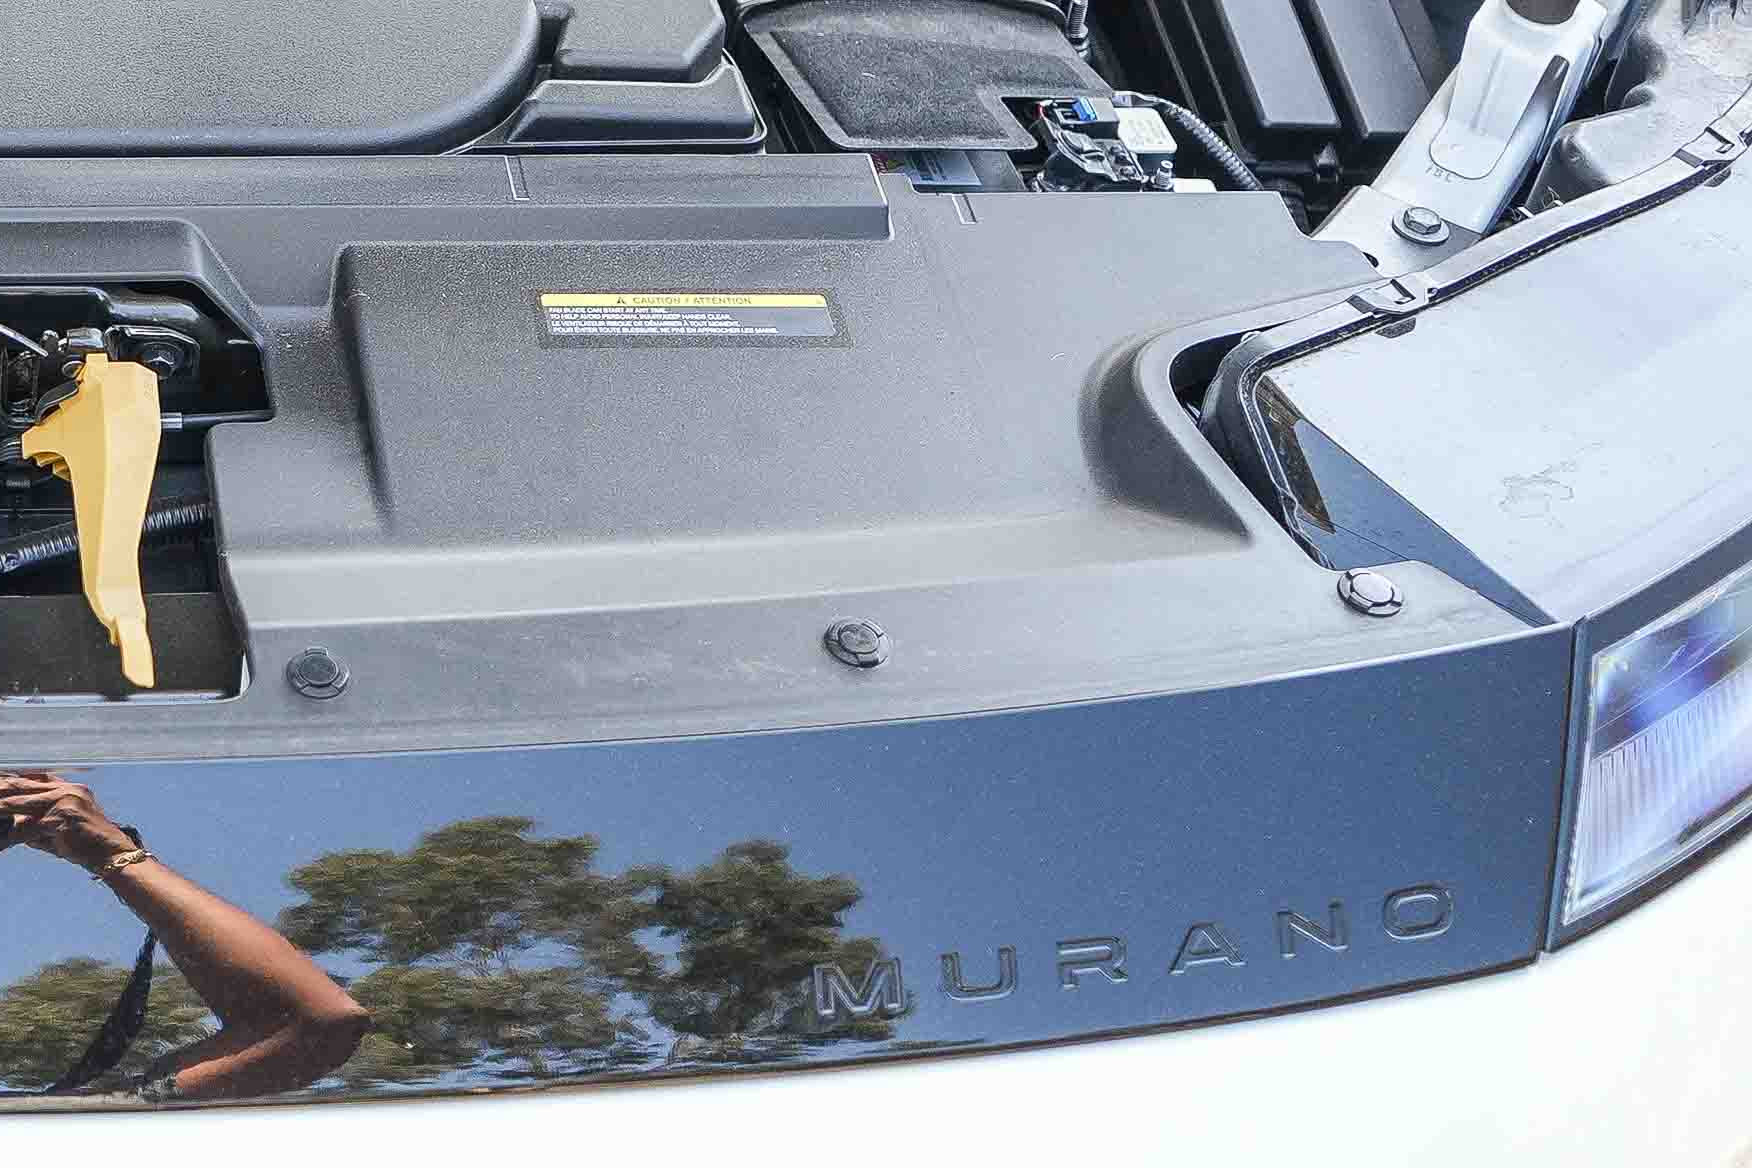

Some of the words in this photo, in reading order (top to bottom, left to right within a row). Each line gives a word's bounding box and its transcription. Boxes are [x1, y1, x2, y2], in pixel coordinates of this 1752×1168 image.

[632, 296, 680, 304] CAUTION
[694, 296, 752, 304] ATTENTION
[812, 882, 1455, 1018] MURANO
